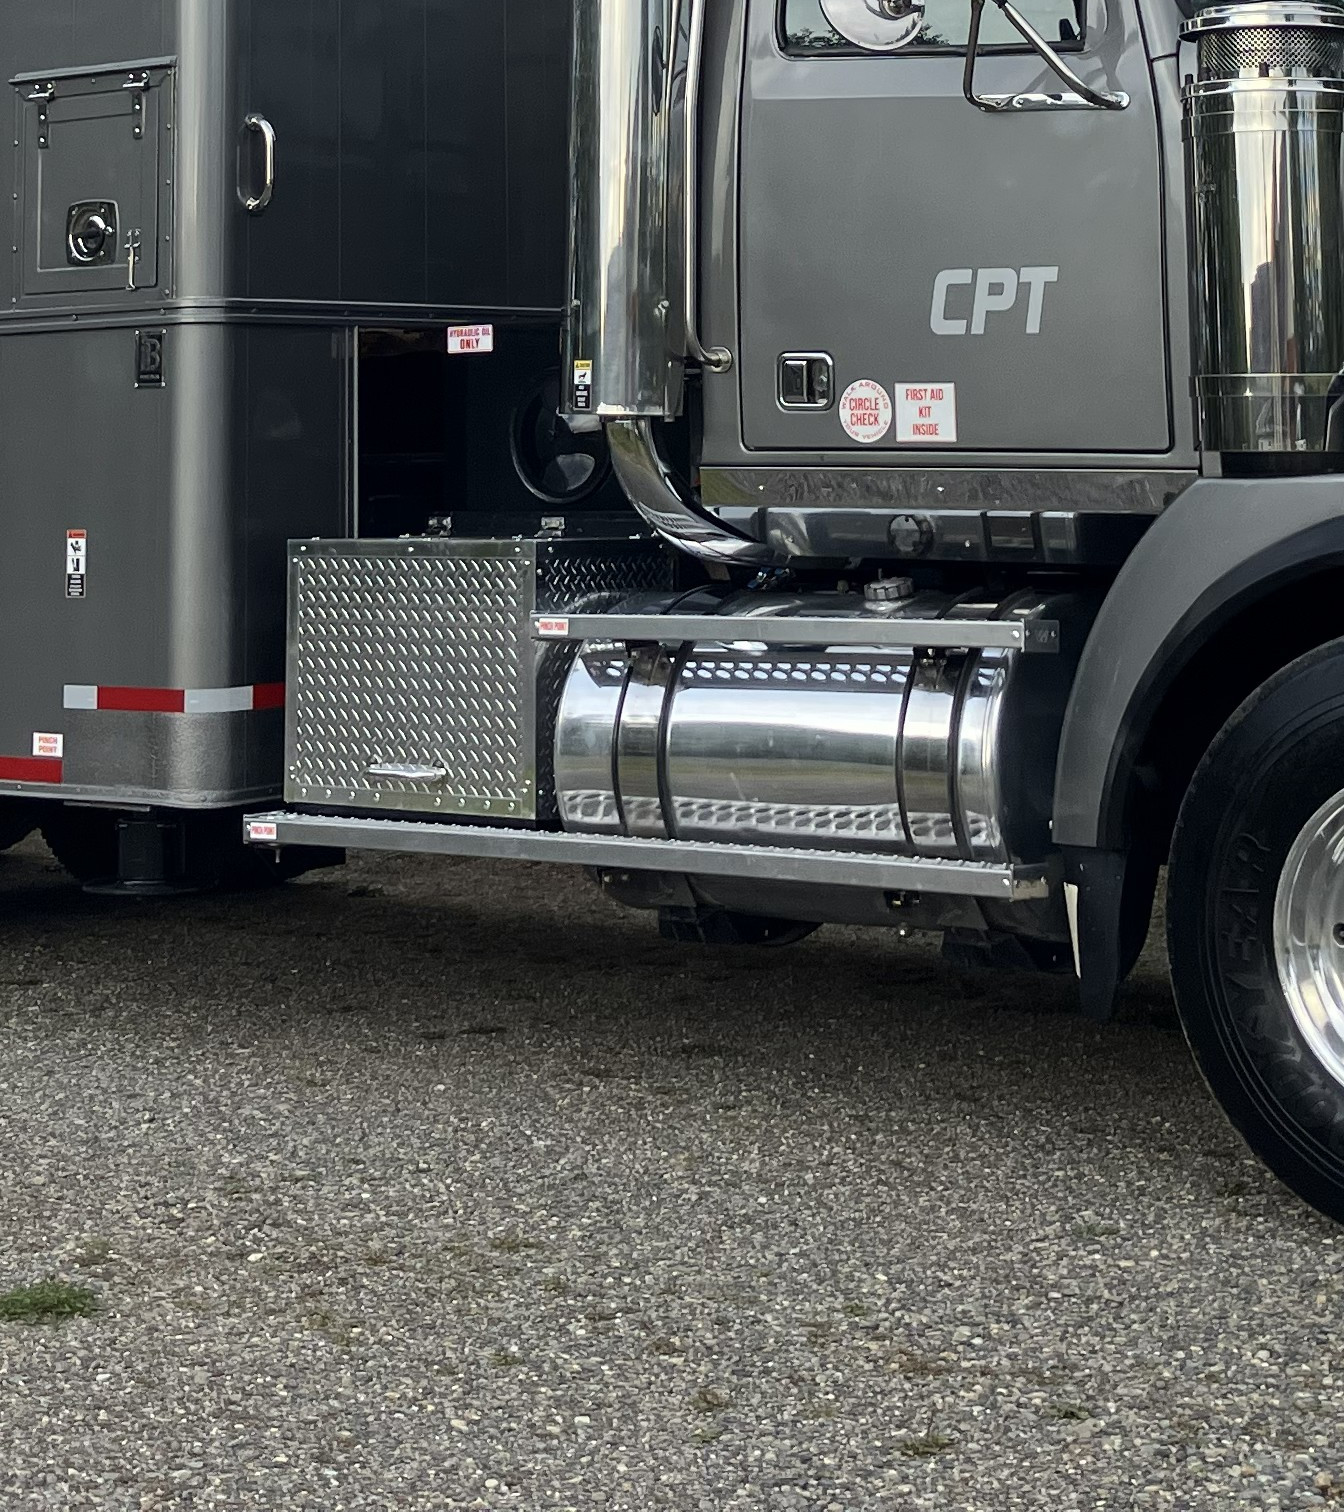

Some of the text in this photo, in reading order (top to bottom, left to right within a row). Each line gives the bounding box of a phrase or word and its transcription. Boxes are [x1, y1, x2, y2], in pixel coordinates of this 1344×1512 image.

[929, 265, 1059, 335] CPT
[449, 327, 491, 338] HYDRAULIC OIL
[459, 338, 480, 350] ONLY
[841, 381, 889, 410] WALK AROUND
[905, 388, 944, 401] FIRST AID
[849, 397, 880, 411] CIRCLE
[918, 405, 932, 418] KIT
[850, 412, 880, 426] CHECK
[912, 423, 940, 436] INSIDE
